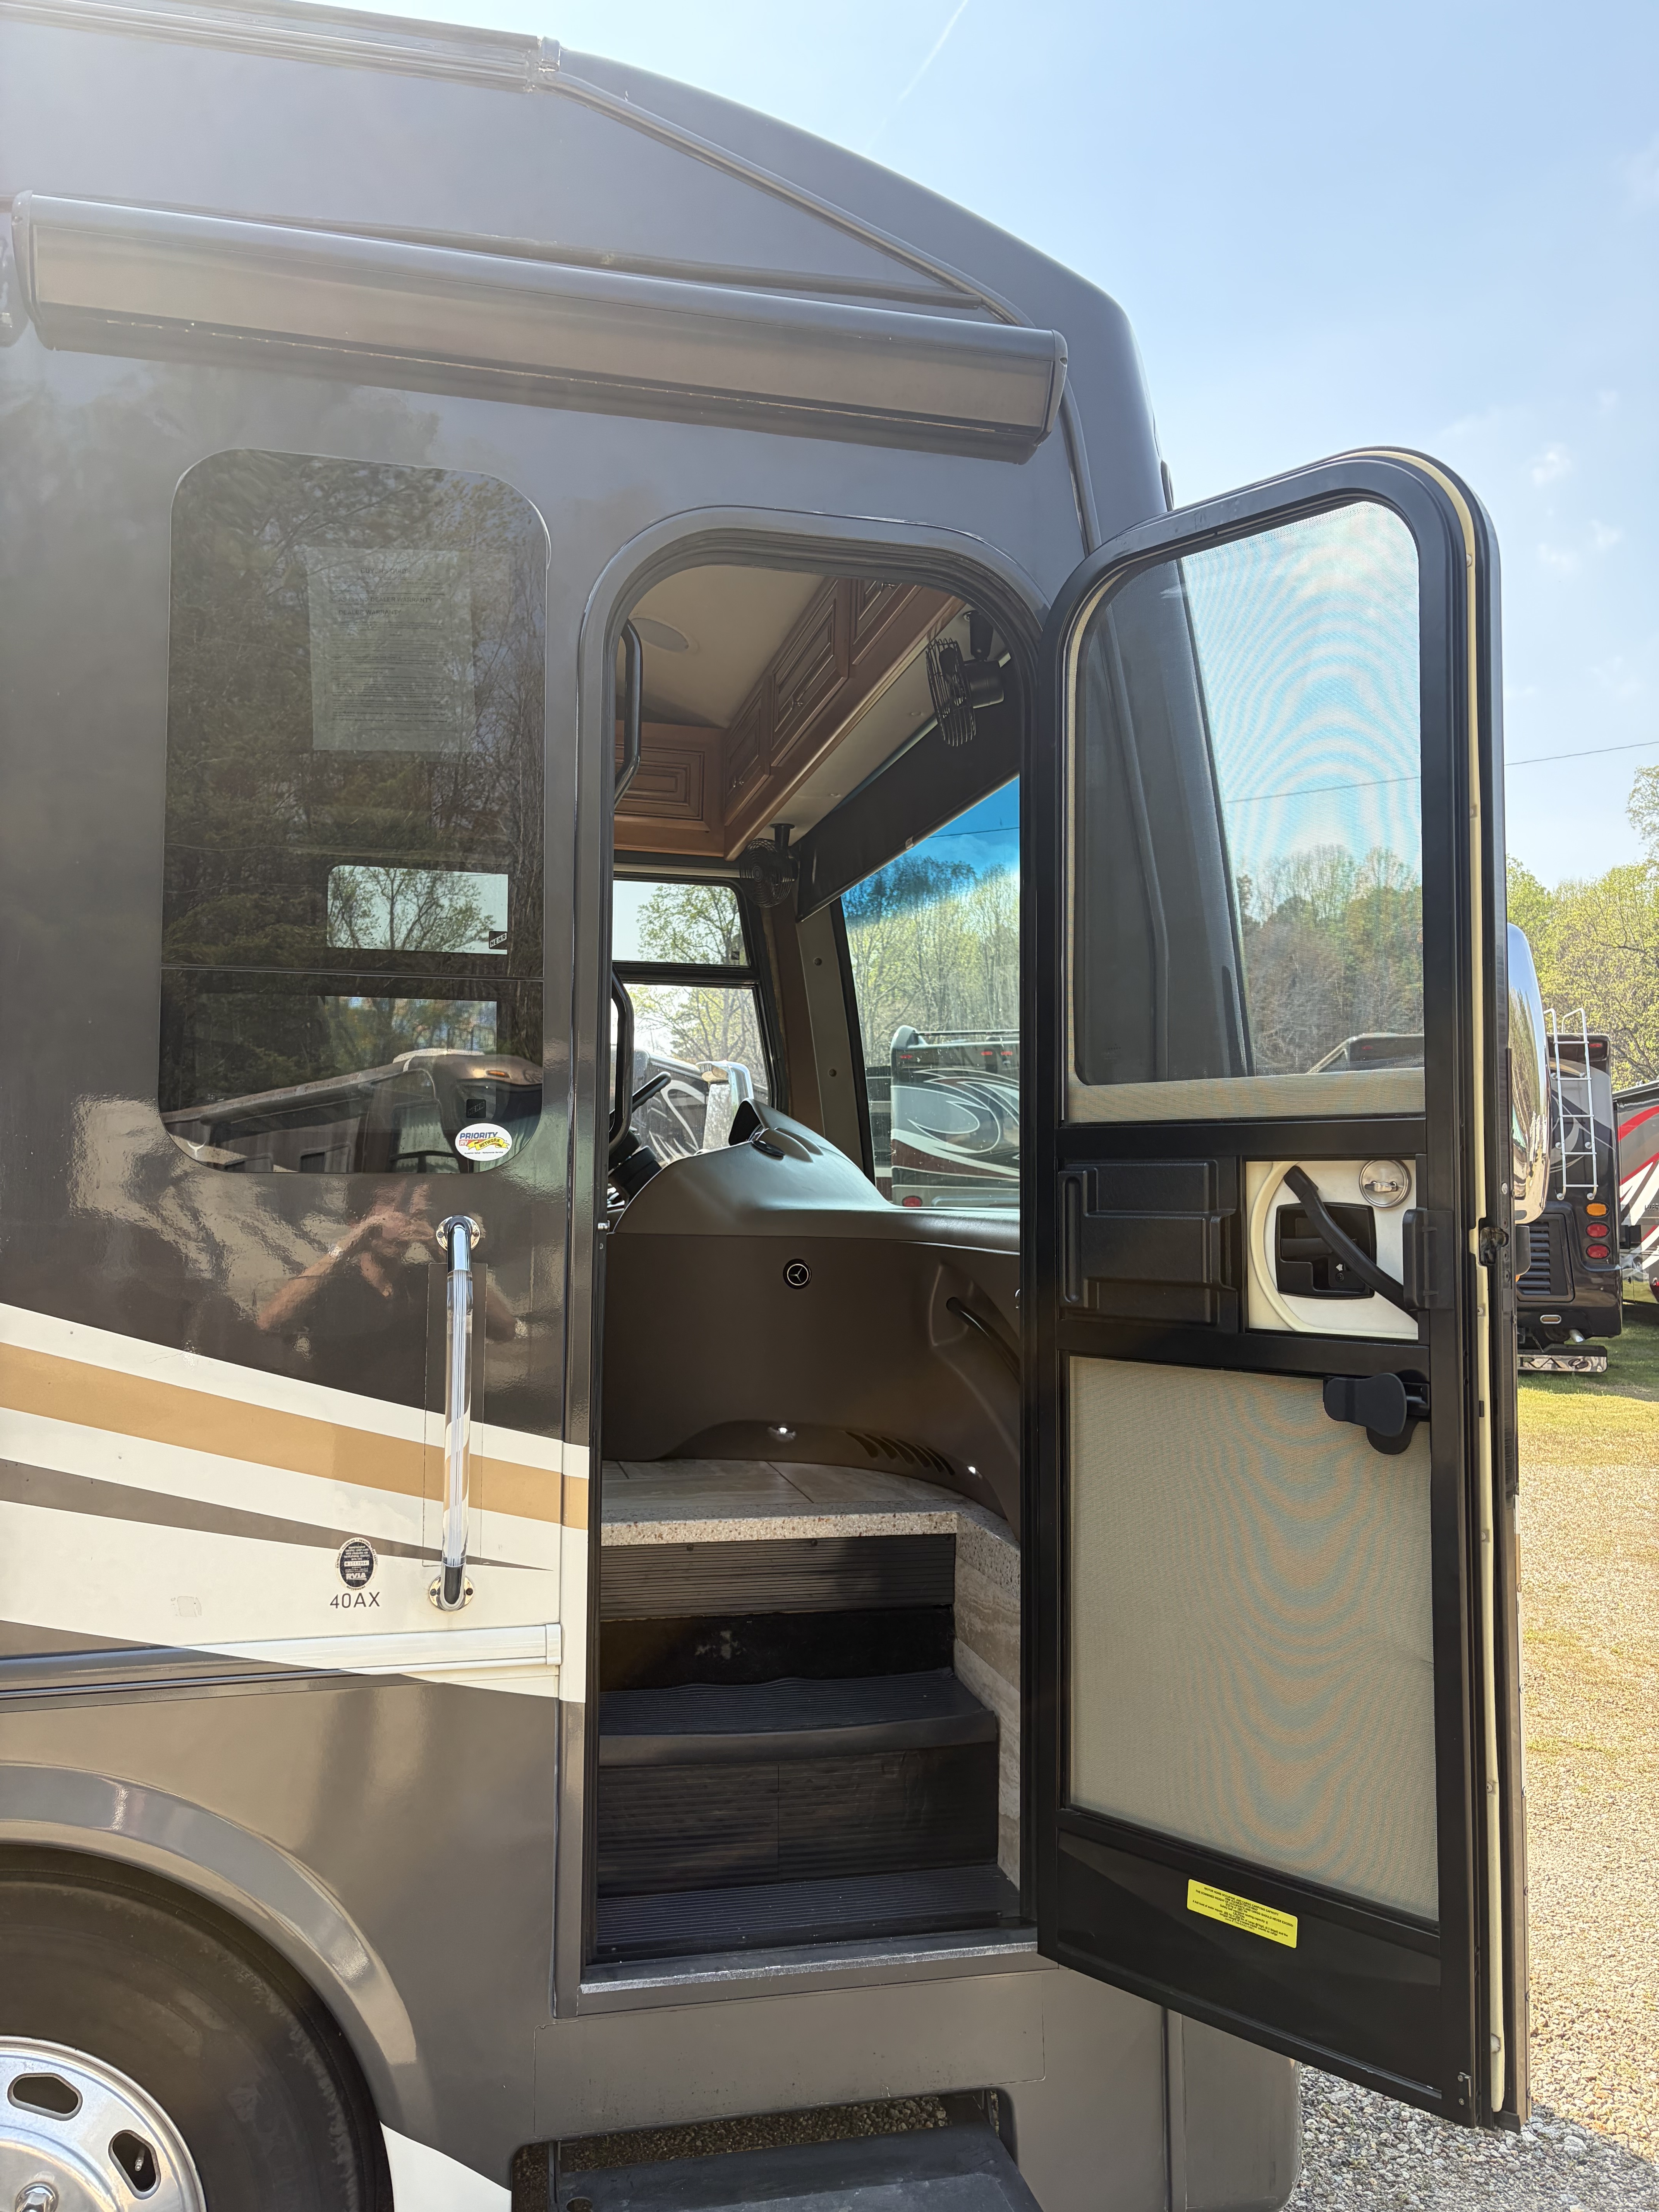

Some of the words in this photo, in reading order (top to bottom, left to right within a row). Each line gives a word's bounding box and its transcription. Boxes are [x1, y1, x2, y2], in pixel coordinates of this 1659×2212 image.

[491, 934, 506, 947] HEHR
[479, 1138, 501, 1148] NETWORK
[330, 1592, 380, 1609] 40AX
